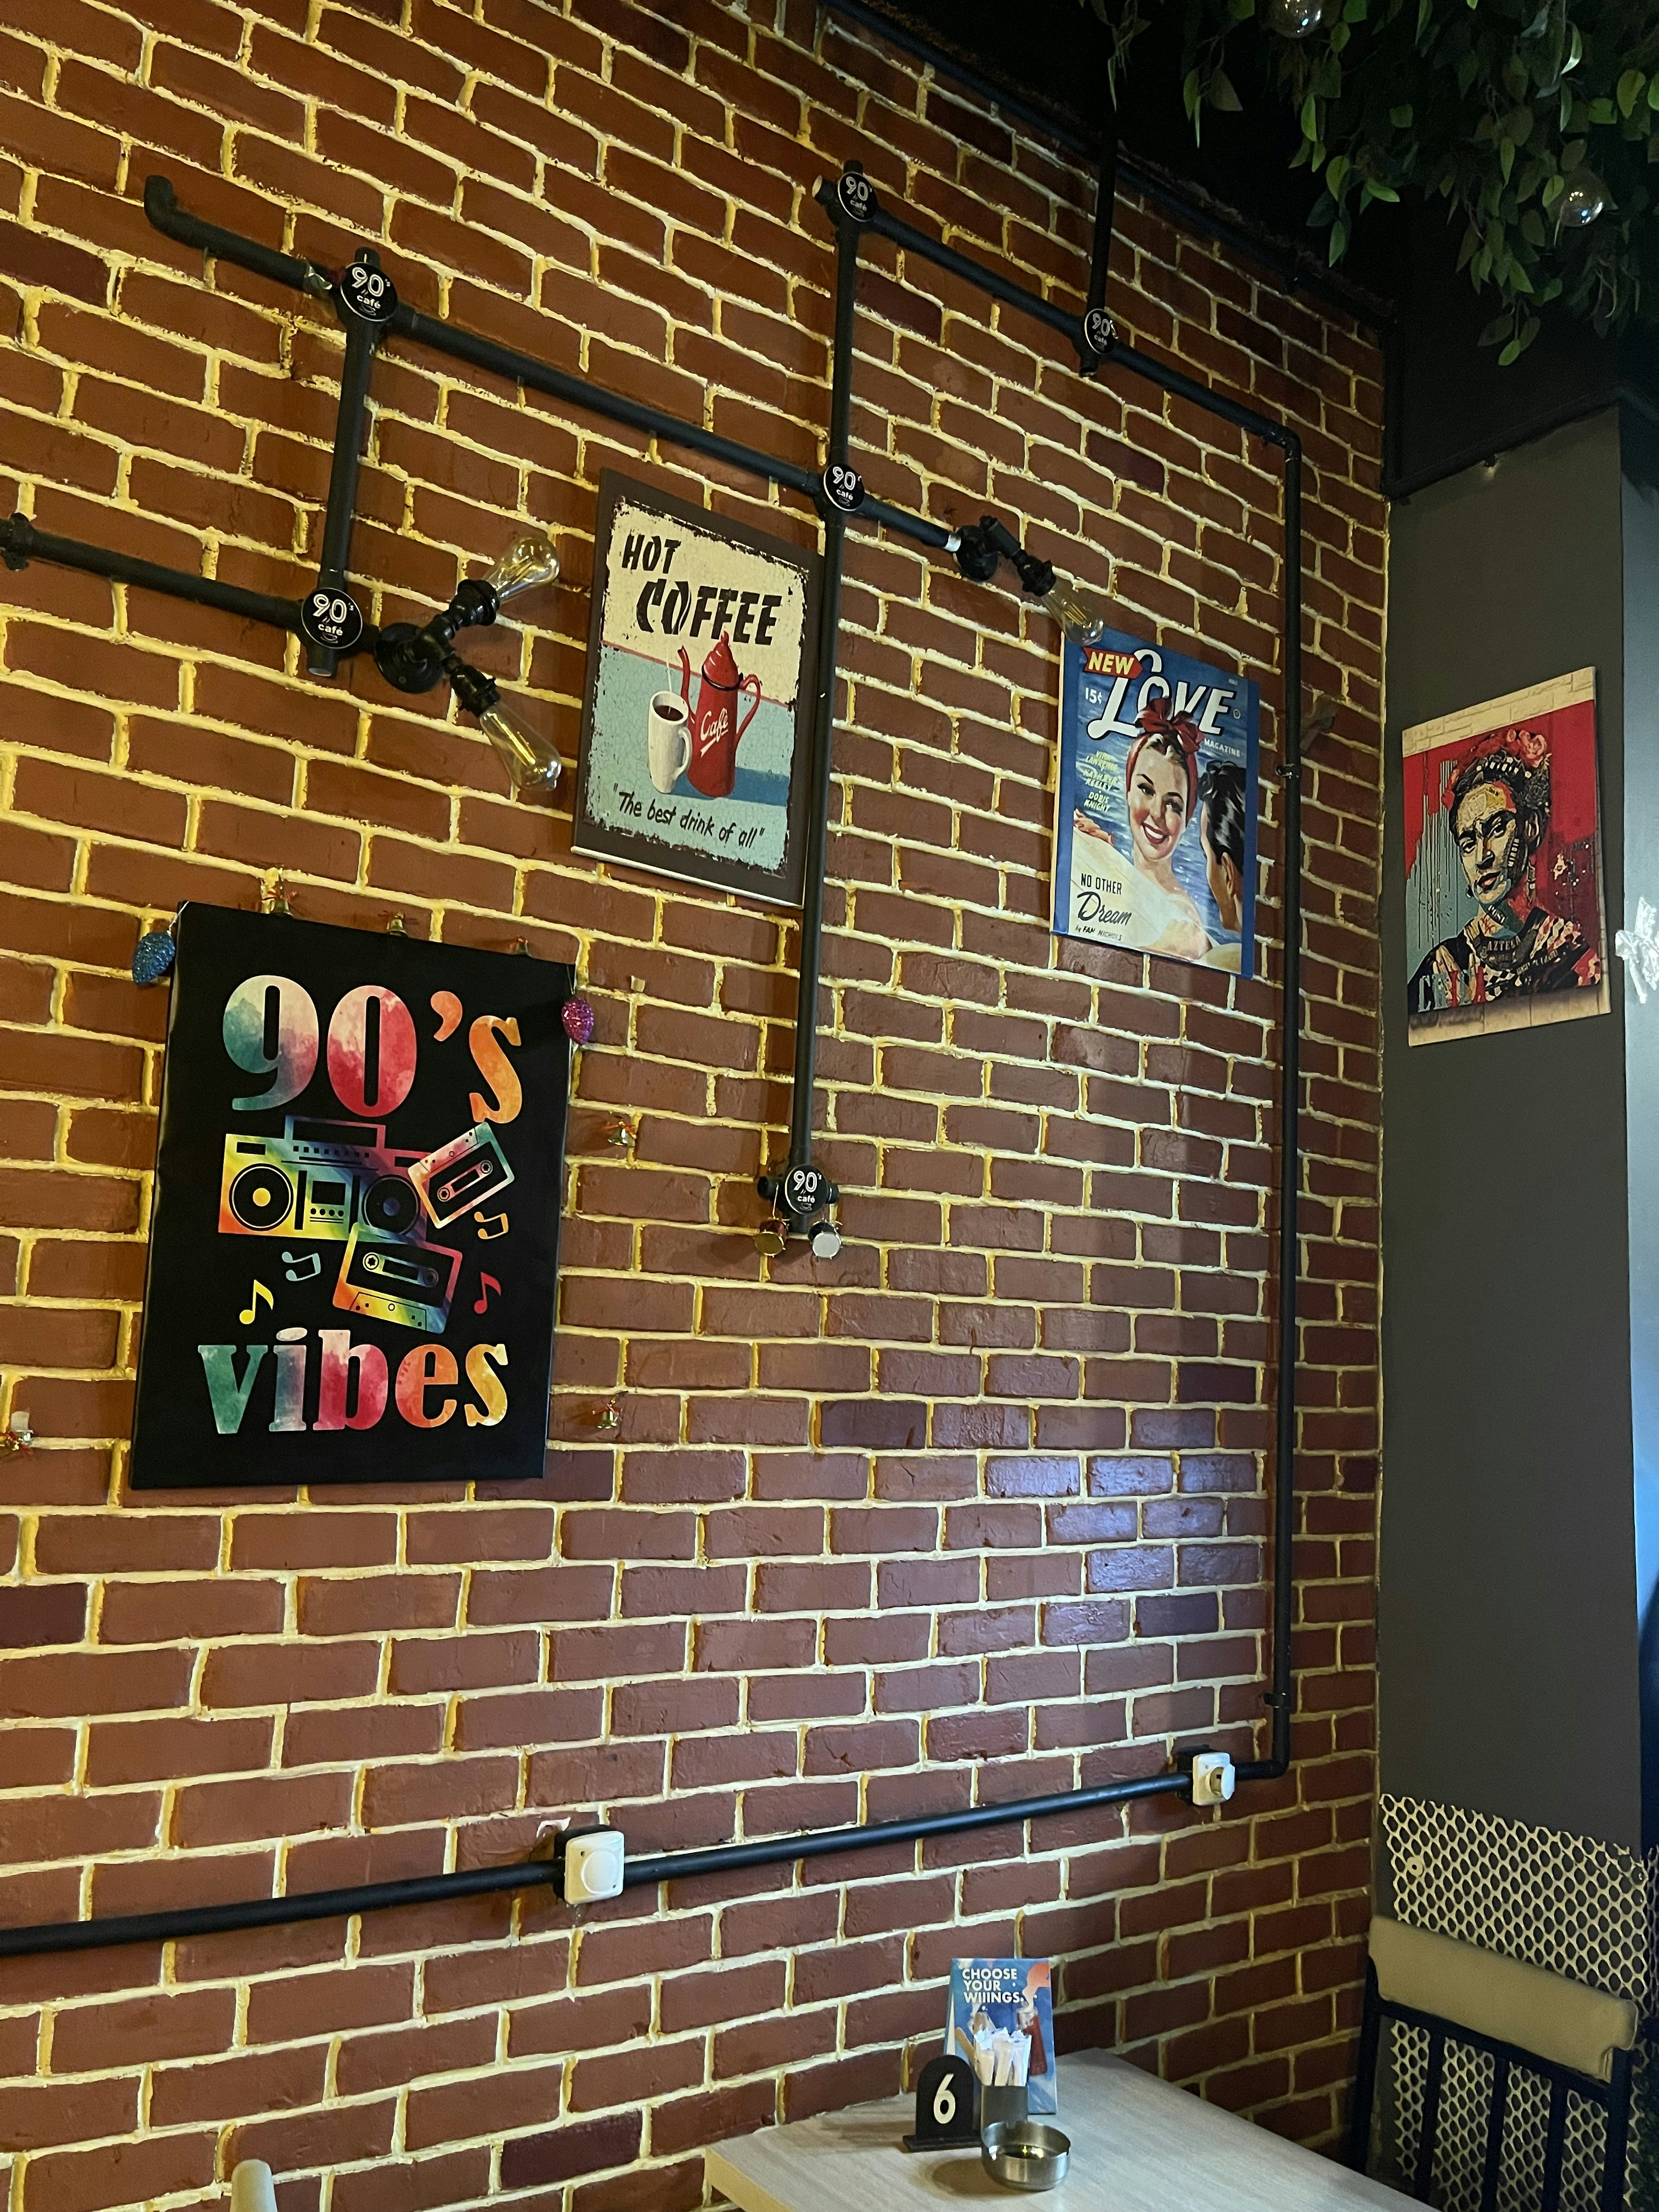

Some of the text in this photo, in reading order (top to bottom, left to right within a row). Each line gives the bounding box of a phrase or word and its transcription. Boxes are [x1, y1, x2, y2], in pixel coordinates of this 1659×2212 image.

[357, 295, 381, 309] café
[621, 534, 681, 574] HOT
[636, 579, 782, 646] COFFEE
[318, 623, 343, 636] café
[1088, 651, 1135, 675] NEW
[1085, 687, 1103, 704] 15¢
[1087, 648, 1234, 739] LOVE
[1204, 737, 1240, 757] MAGAZINE
[1084, 799, 1110, 812] KNIGHT
[1088, 791, 1109, 804] DORIS
[647, 799, 677, 825] best
[680, 809, 715, 837] drink
[718, 822, 737, 844] of
[1081, 873, 1122, 895] NO OTHER
[1076, 891, 1132, 926] Dream
[1098, 930, 1122, 941] NICHOLS
[222, 974, 523, 1125] 90's
[797, 1195, 815, 1203] café
[198, 1327, 509, 1434] vibes
[962, 1968, 1018, 1980] CHOOSE
[963, 1980, 1001, 1991] YOUR
[933, 2073, 956, 2124] 6
